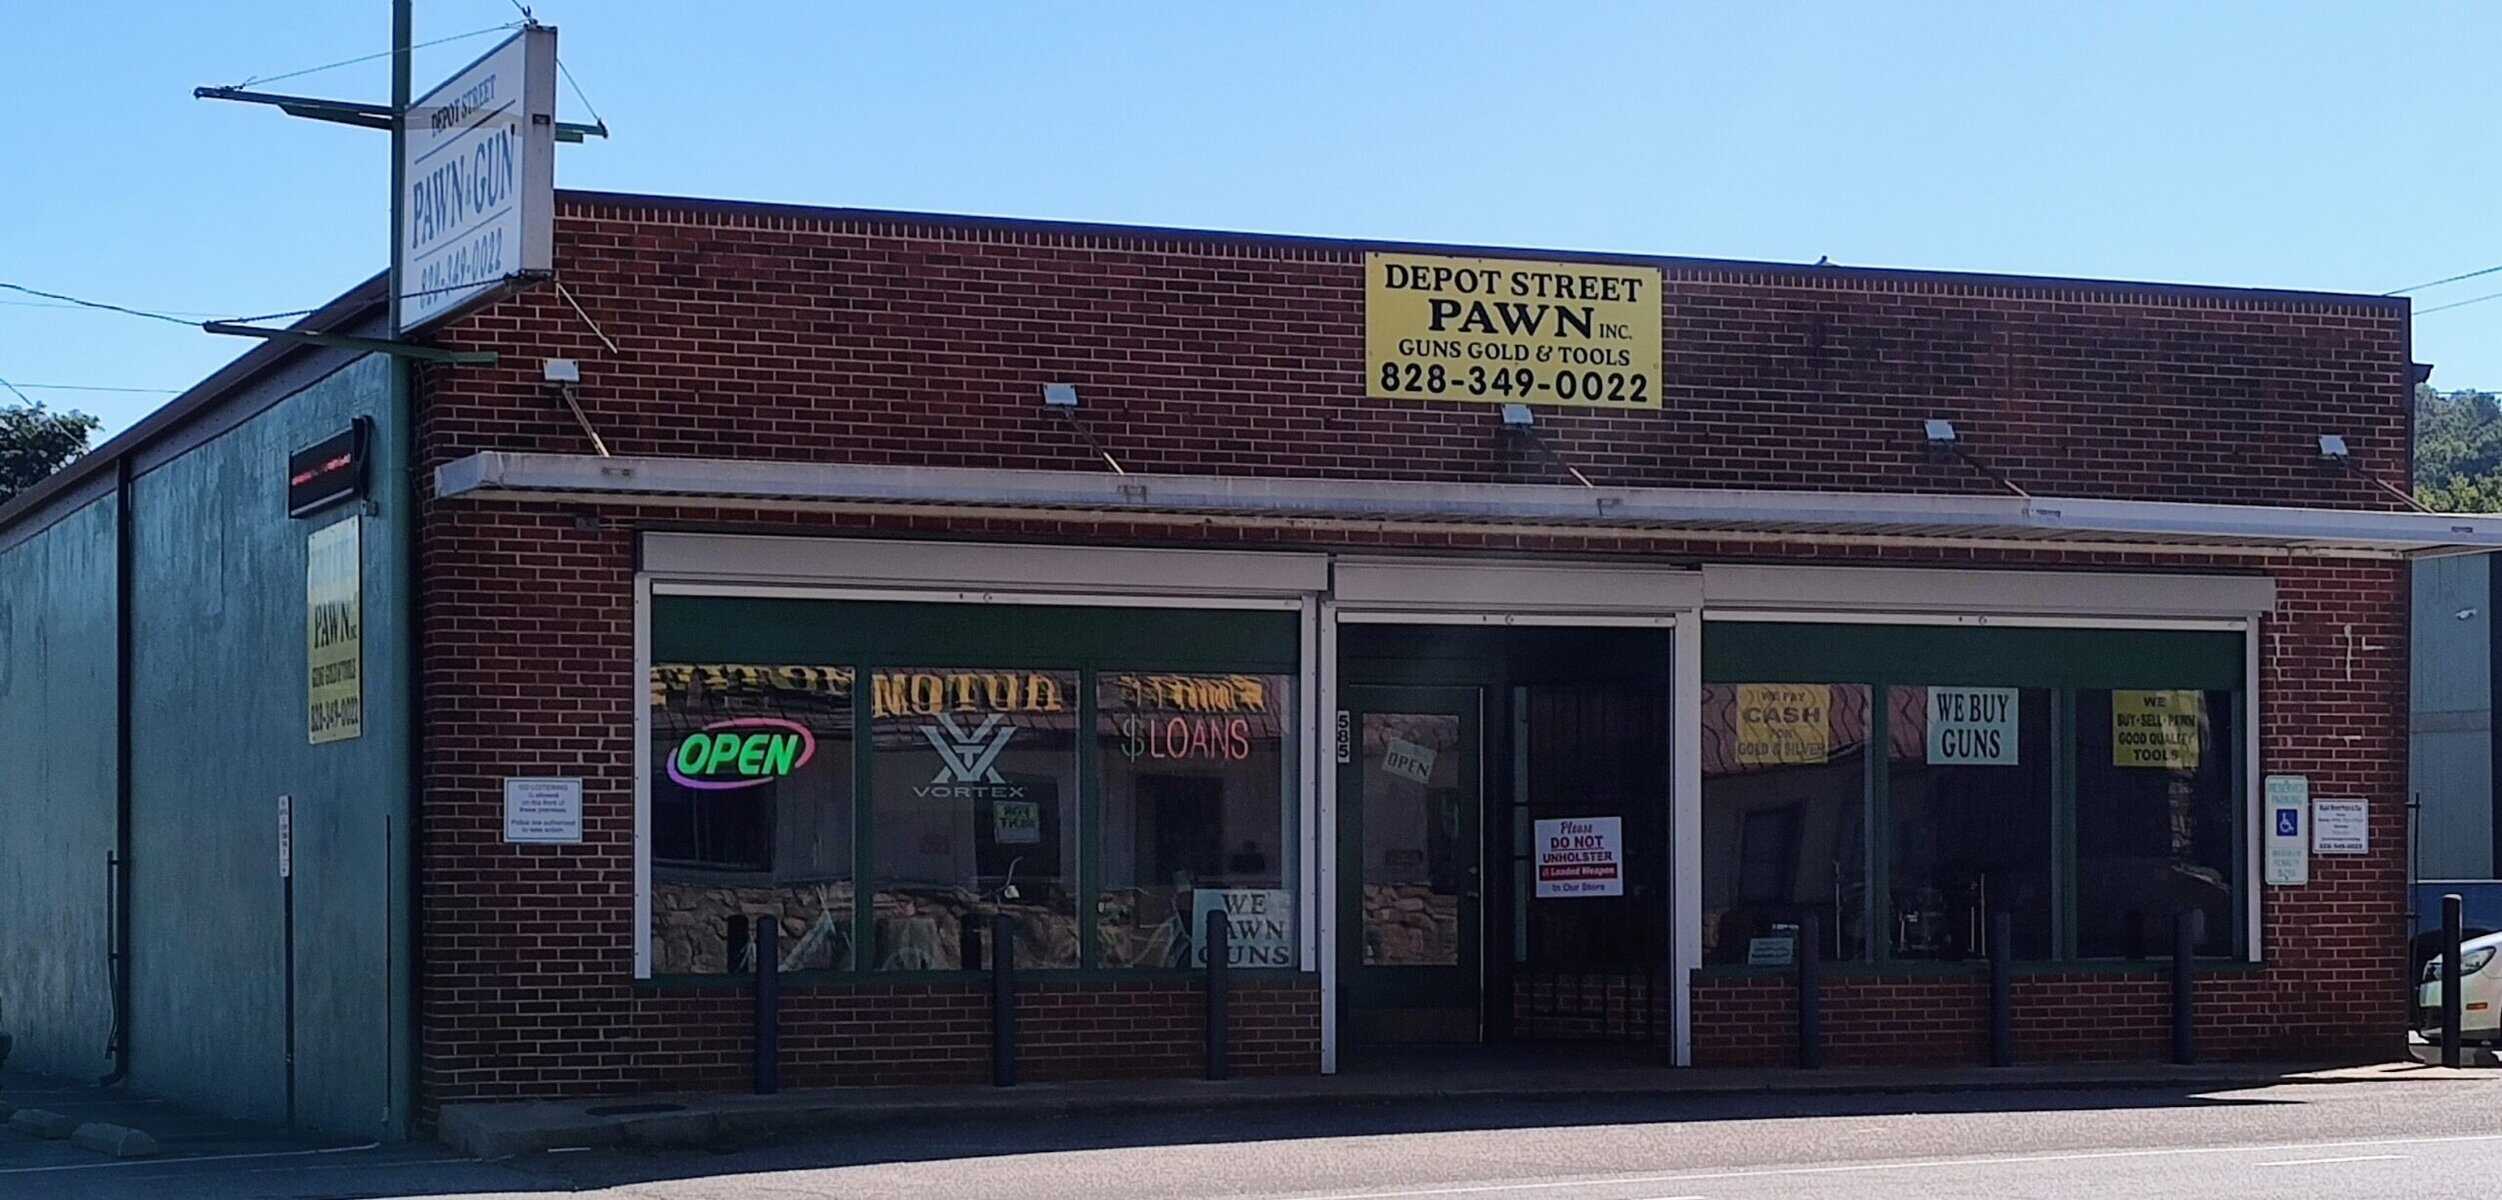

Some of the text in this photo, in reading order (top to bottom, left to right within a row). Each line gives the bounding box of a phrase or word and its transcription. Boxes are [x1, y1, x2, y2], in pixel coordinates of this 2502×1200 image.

[431, 74, 497, 138] DEPOT STREET
[412, 155, 465, 249] PAWN
[473, 124, 516, 214] GUN
[1385, 263, 1643, 303] DEPOT STREET
[1428, 298, 1633, 341] PAWN INC.
[1398, 338, 1631, 367] GUNS GOLD & TOOLS
[1380, 361, 1648, 403] 828-349-0022
[314, 601, 350, 649] PAWN
[1936, 693, 2010, 723] WE BUY
[2143, 696, 2168, 708] WE
[1743, 707, 1821, 724] CASH
[1738, 742, 1769, 755] GOLD
[1941, 728, 2001, 758] GUNS
[2118, 732, 2147, 745] GOOD
[674, 731, 801, 777] OPEN
[1387, 751, 1431, 778] OPEN
[2133, 749, 2178, 761] TOOLS
[912, 785, 1026, 799] VORTEX
[1560, 821, 1593, 835] Please
[1550, 835, 1604, 849] DO NOT
[1542, 851, 1613, 864] UNHOLSTER
[1221, 892, 1266, 914] WE
[1225, 918, 1285, 940] AWN
